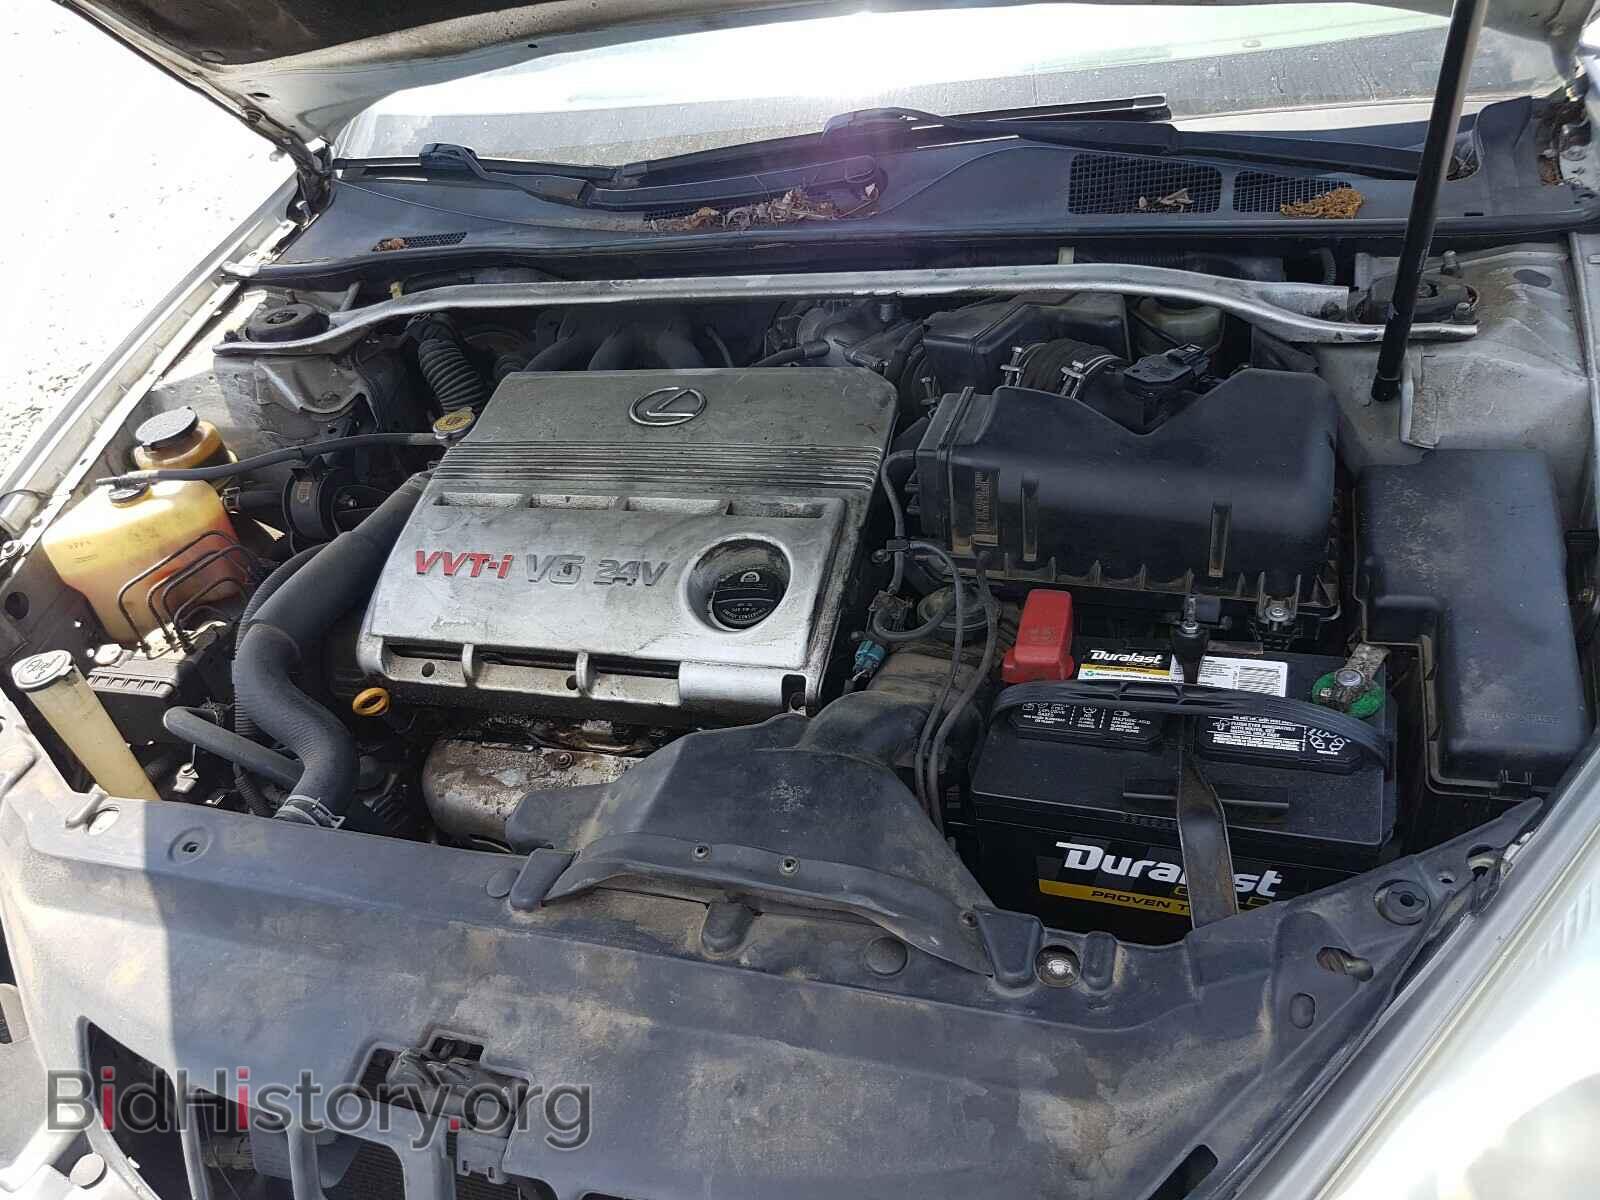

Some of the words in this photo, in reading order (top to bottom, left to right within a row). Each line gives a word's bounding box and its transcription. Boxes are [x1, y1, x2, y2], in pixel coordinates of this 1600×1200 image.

[415, 550, 513, 579] VVT-i
[527, 554, 585, 584] V6
[593, 559, 669, 586] 24V
[1090, 649, 1164, 664] Duralast
[1091, 889, 1170, 909] PROVEN
